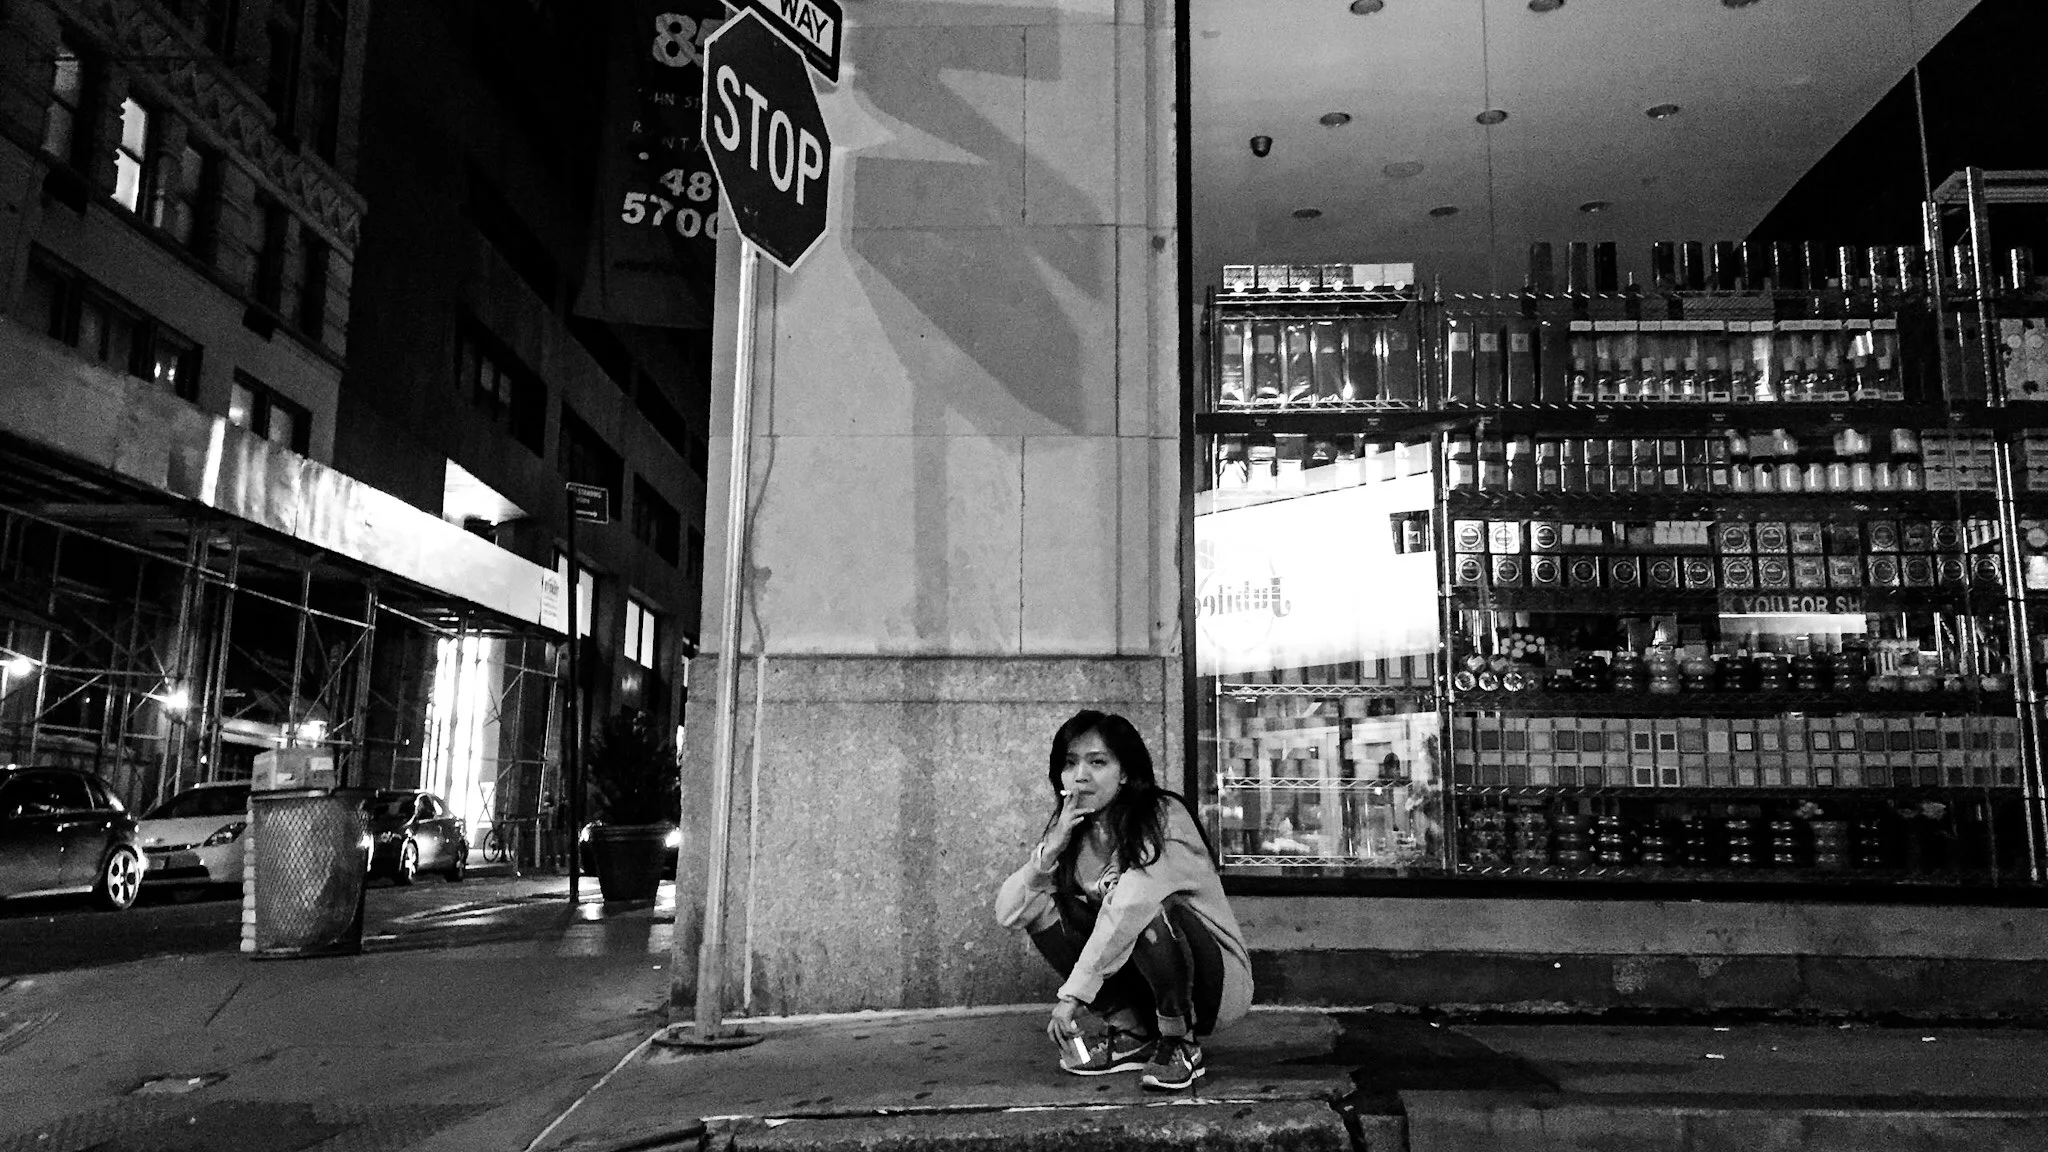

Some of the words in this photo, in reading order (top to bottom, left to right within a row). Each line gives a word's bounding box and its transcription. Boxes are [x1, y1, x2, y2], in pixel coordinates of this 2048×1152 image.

[780, 0, 829, 43] WAY
[714, 65, 823, 205] STOP
[1787, 595, 1829, 613] FOR
